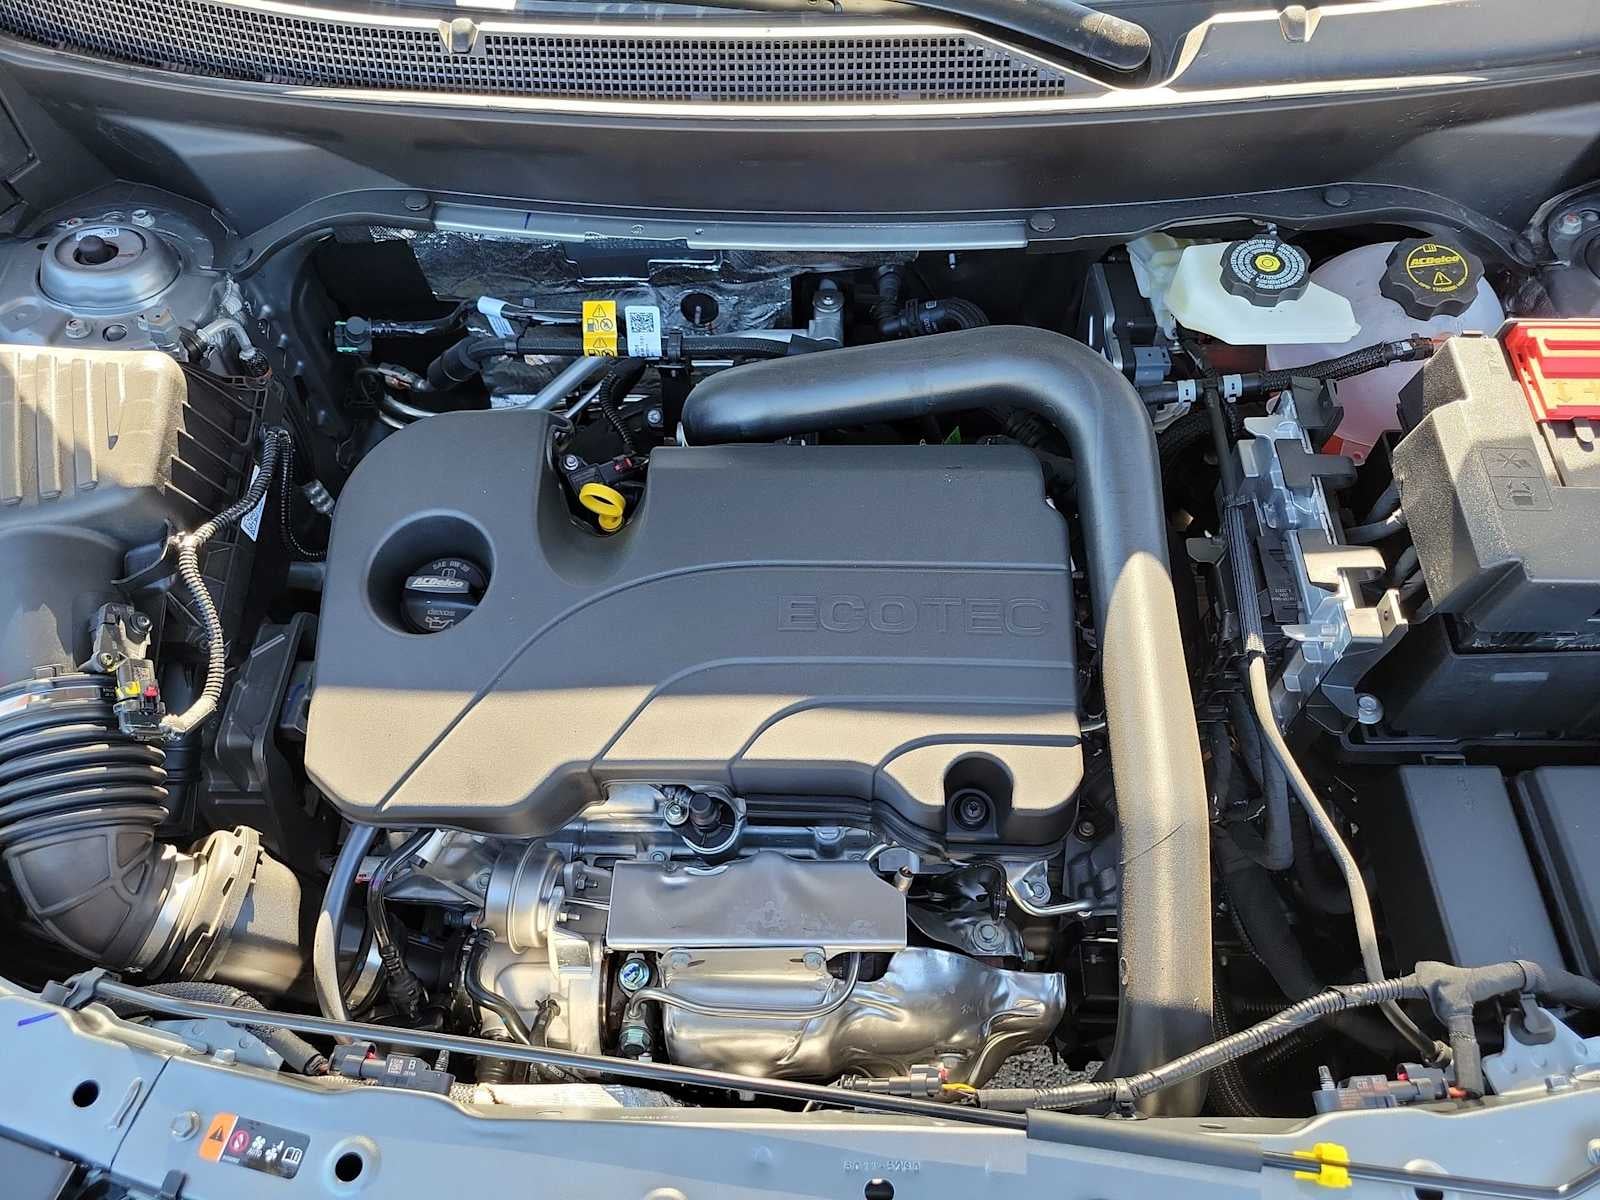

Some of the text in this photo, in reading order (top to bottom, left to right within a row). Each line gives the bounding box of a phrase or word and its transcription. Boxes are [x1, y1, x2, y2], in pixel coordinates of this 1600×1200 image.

[1410, 255, 1460, 267] ACDelco
[432, 561, 447, 570] SAE
[412, 577, 464, 588] ACDelco
[777, 594, 1050, 638] ECOTEC
